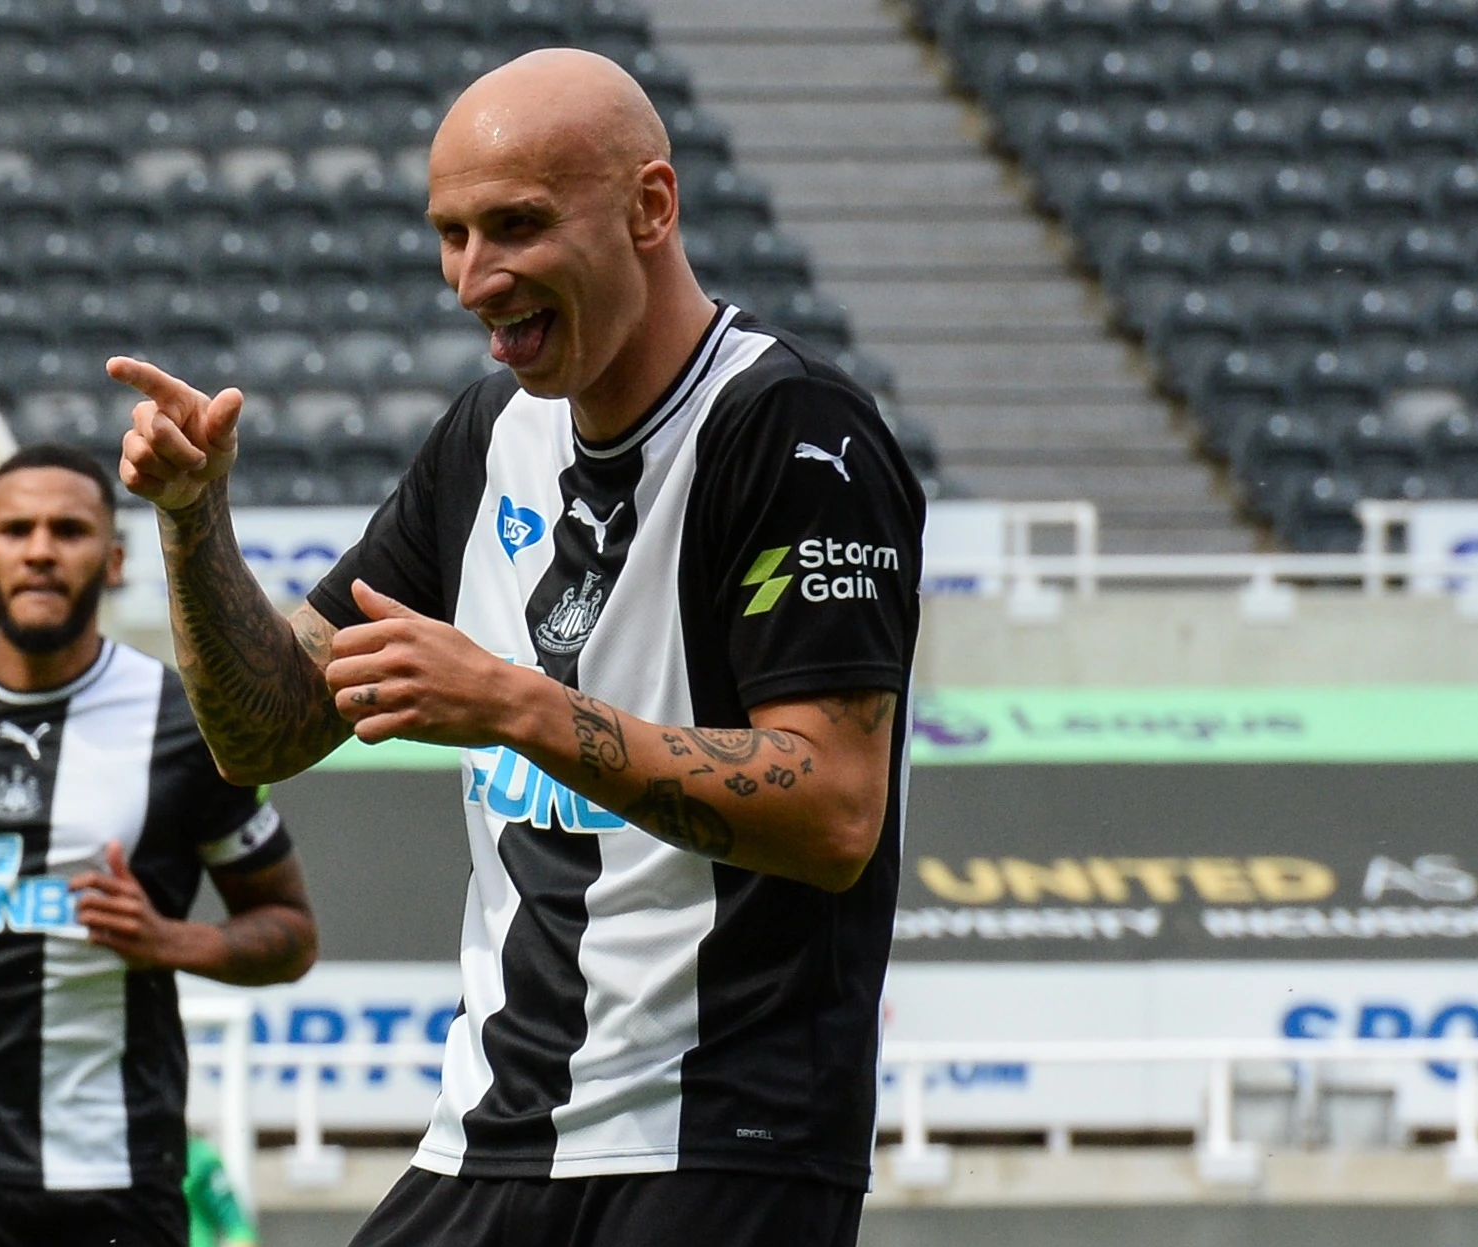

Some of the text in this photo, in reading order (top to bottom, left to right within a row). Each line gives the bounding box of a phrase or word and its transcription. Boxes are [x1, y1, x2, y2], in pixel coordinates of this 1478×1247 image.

[798, 537, 899, 571] Storm
[800, 570, 878, 602] Gain
[917, 854, 1478, 902] UNITED AS
[735, 1127, 775, 1141] DRYCELL
